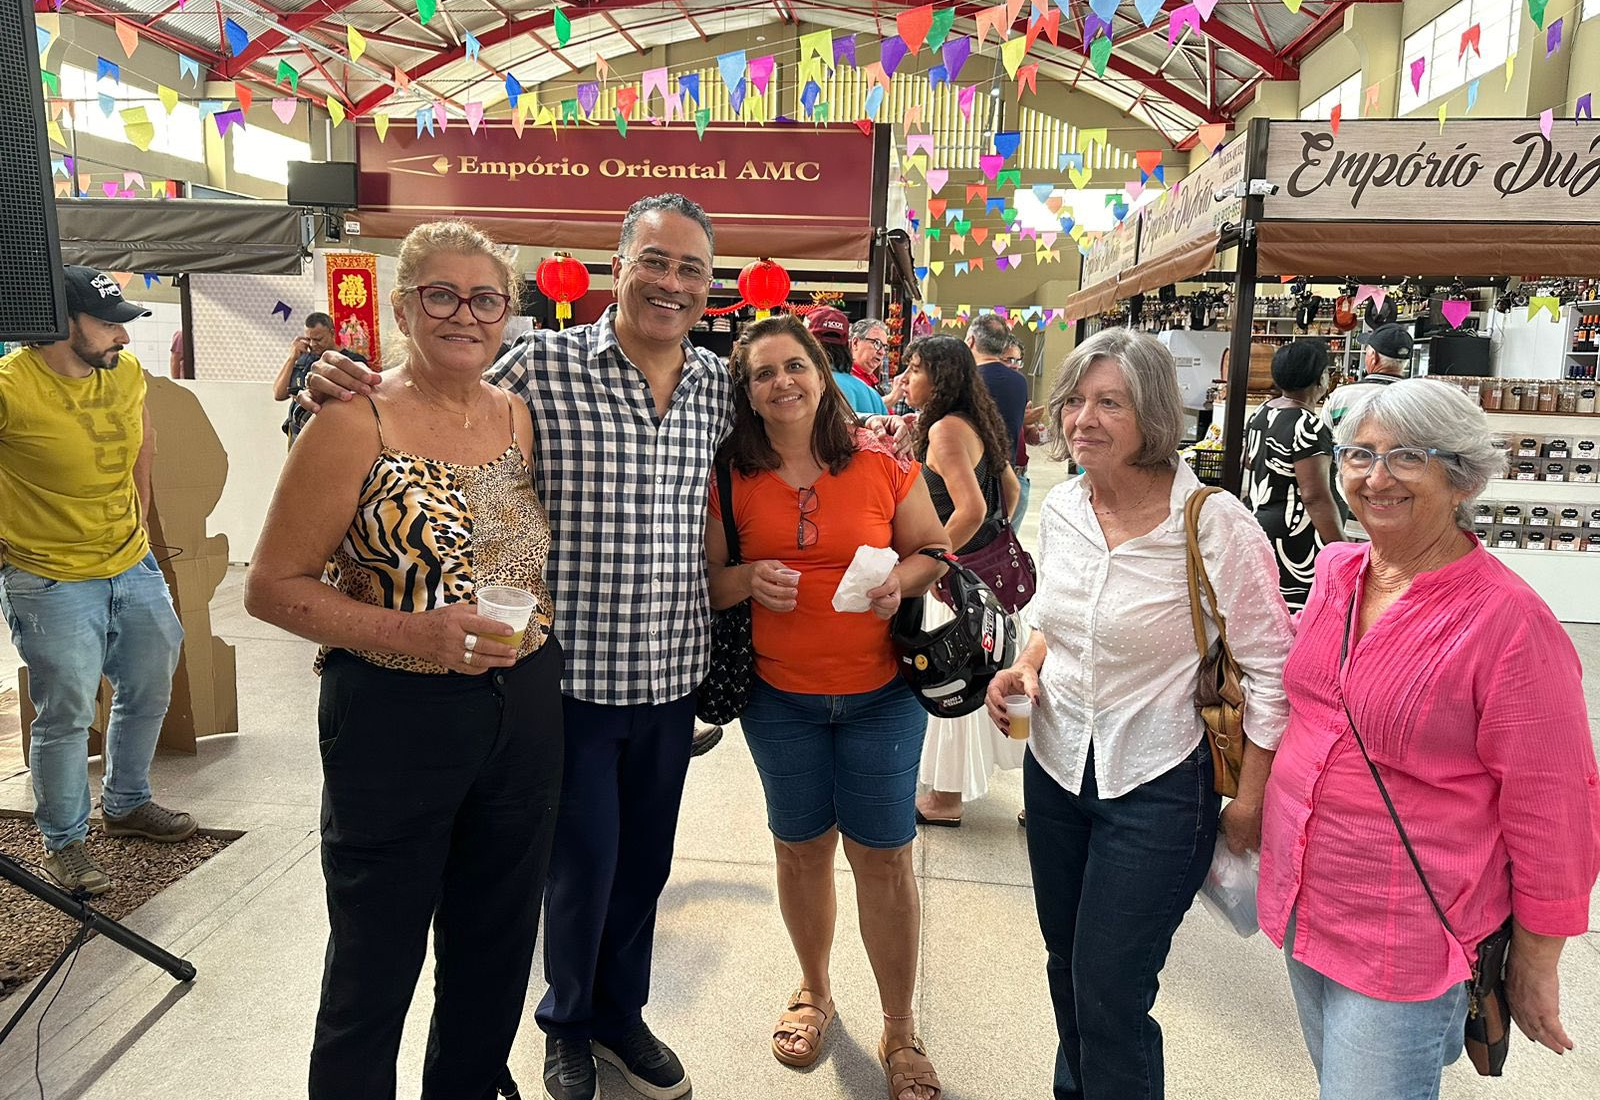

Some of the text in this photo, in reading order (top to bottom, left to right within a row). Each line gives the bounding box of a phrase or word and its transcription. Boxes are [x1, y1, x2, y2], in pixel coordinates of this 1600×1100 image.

[457, 155, 820, 182] Empório Oriental AMC
[1287, 131, 1485, 209] Empório
